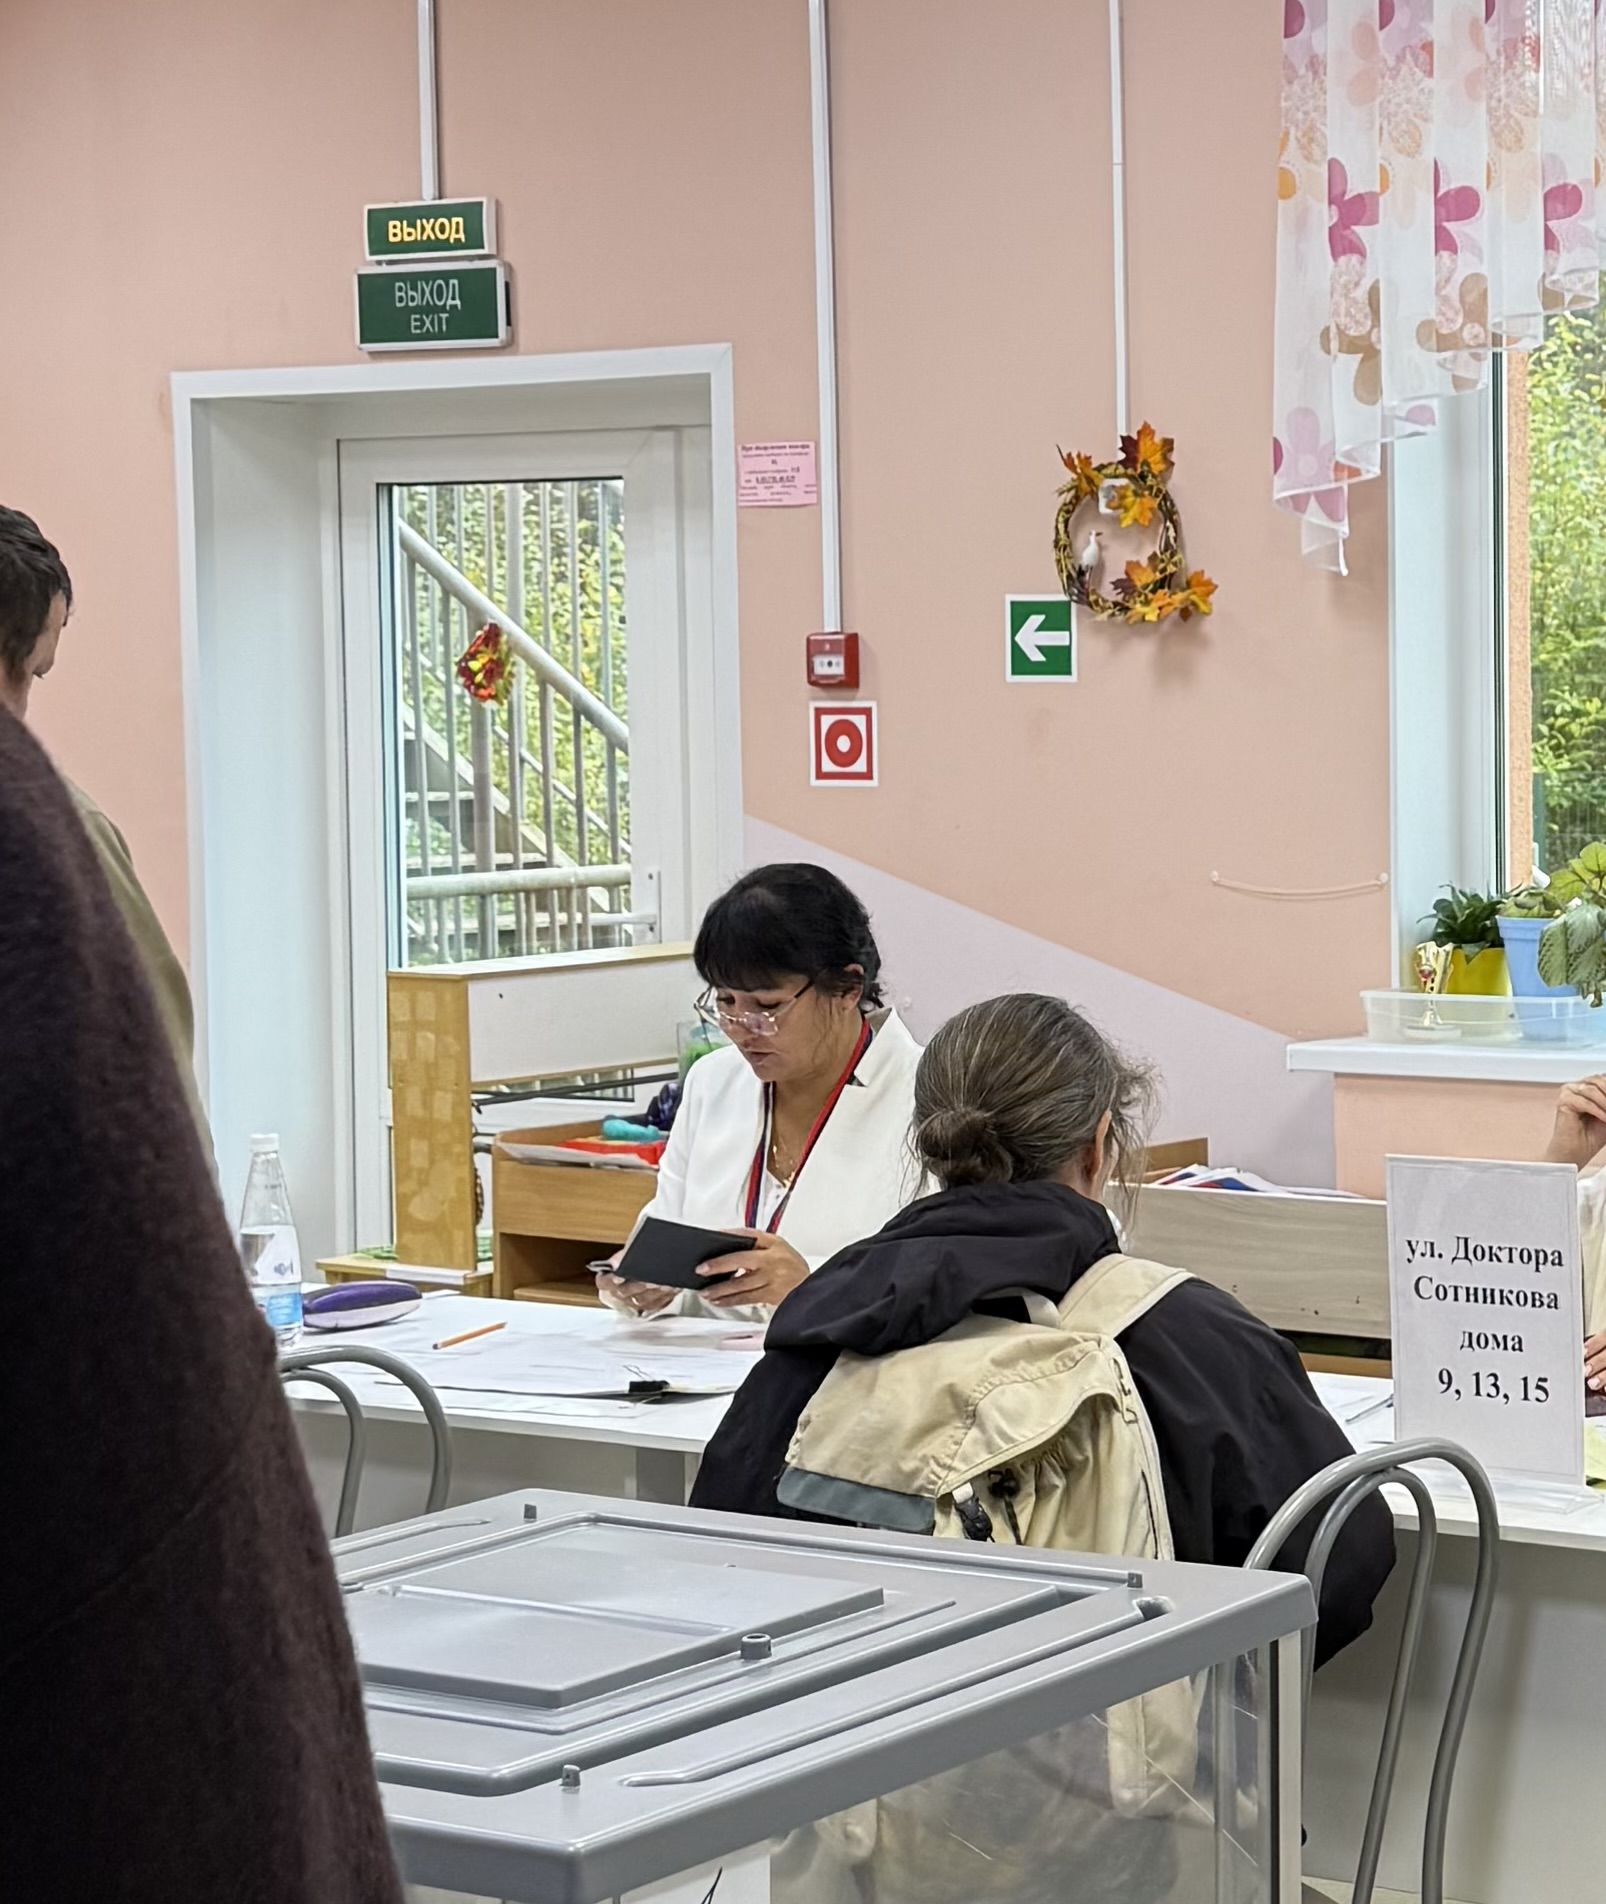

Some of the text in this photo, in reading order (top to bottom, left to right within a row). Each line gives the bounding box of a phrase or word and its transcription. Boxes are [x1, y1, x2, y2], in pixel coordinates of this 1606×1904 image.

[388, 217, 466, 244] ВЫХОД
[394, 279, 462, 311] ВЫХОД
[410, 313, 450, 334] EXIT
[1405, 1236, 1565, 1273] ул. Доктора
[1413, 1275, 1560, 1310] Сотникова
[1459, 1330, 1524, 1353] дома
[1438, 1368, 1550, 1405] 9, 13, 15
